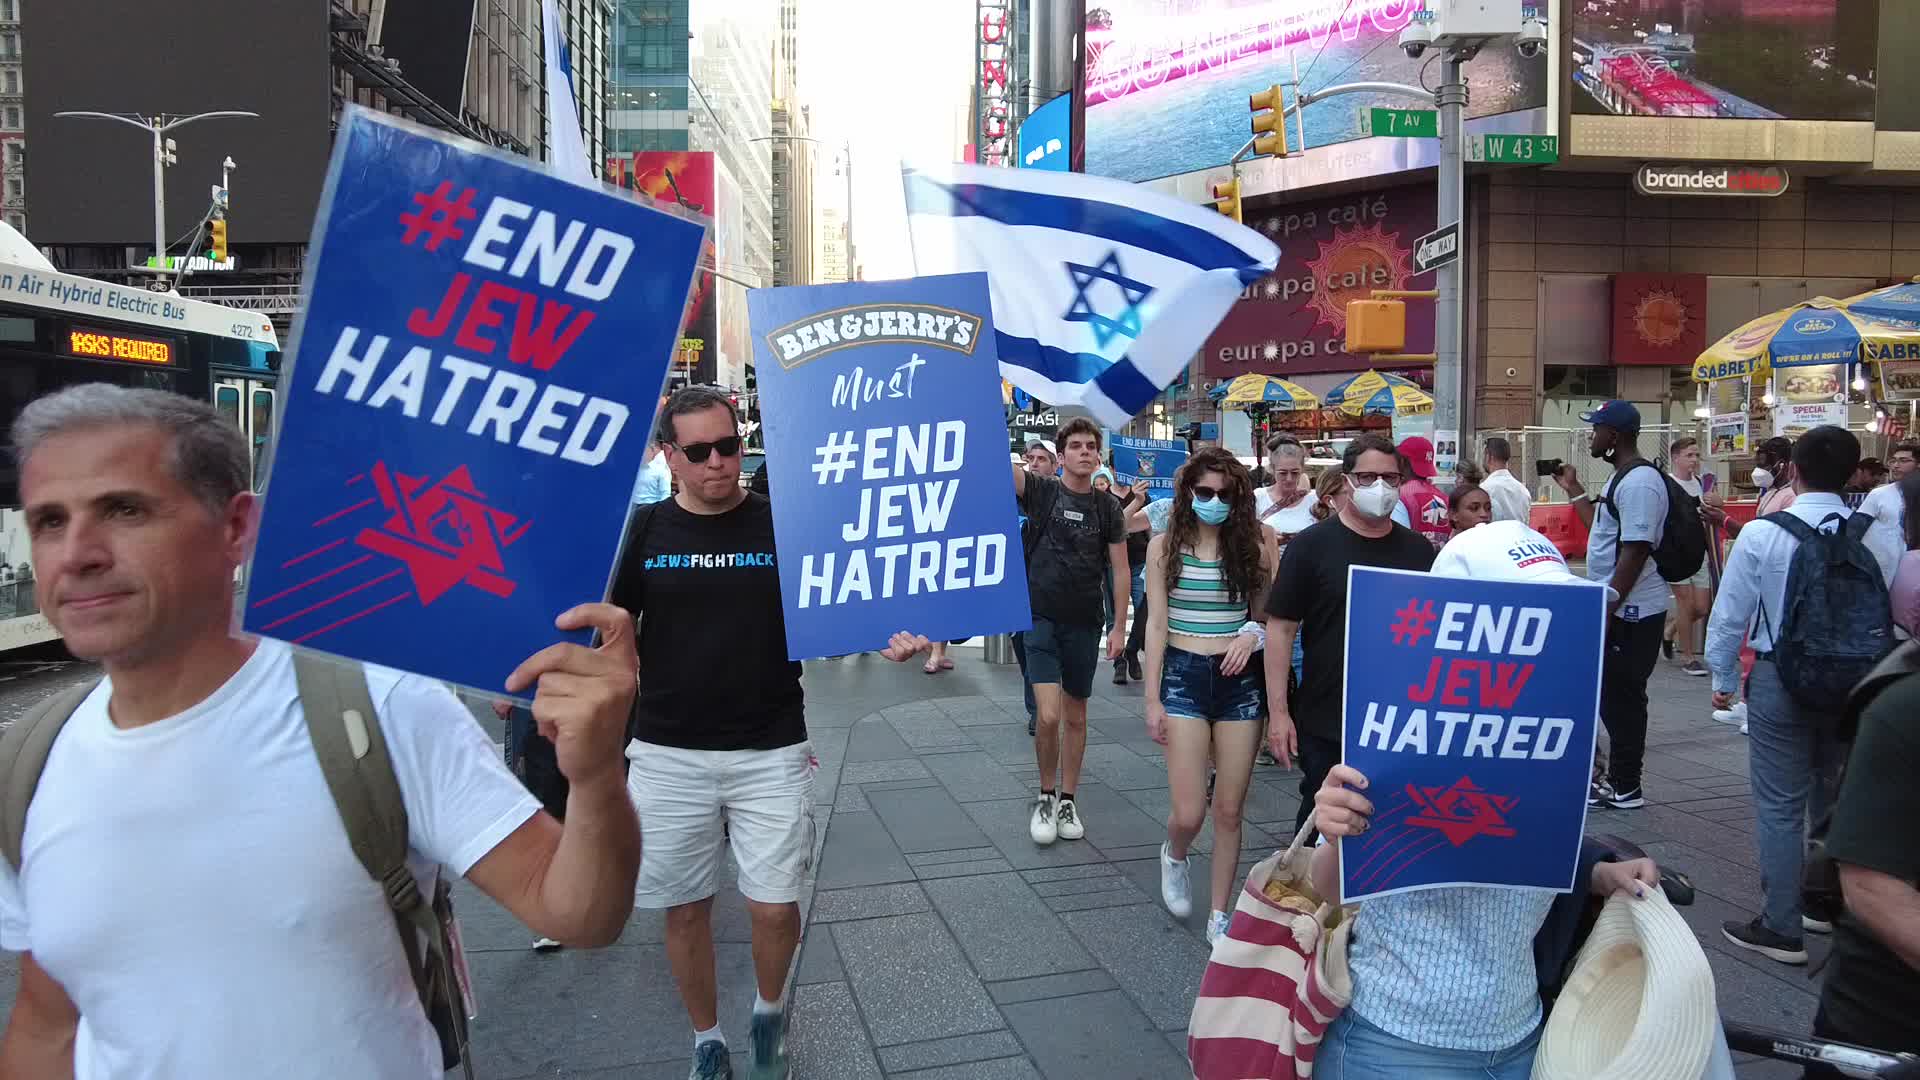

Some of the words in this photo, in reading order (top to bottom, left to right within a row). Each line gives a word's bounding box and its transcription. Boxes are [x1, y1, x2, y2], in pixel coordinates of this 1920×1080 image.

[1522, 8, 1536, 17] YPD
[1388, 113, 1397, 134] 7
[1404, 114, 1420, 127] Av
[1489, 138, 1504, 159] W
[1512, 138, 1533, 159] 43
[1541, 138, 1553, 152] St
[399, 180, 635, 301] #END
[1420, 244, 1432, 261] ONE
[1438, 234, 1454, 255] WAY
[18, 275, 44, 295] Air
[50, 280, 100, 306] Hybrid
[107, 291, 158, 316] Electric
[162, 303, 185, 321] Bus
[231, 323, 253, 338] 4272
[406, 272, 596, 371] JEW
[112, 337, 169, 362] REQUIRED
[1219, 339, 1315, 363] europa
[1822, 352, 1841, 360] ROLL
[315, 325, 631, 467] HATRED
[832, 353, 926, 411] Must
[1792, 405, 1828, 414] SPECIAL
[811, 420, 966, 485] #END
[1122, 437, 1133, 447] END
[1134, 439, 1146, 448] JEW
[1147, 440, 1173, 449] HATRED
[842, 479, 960, 542] JEW
[644, 552, 774, 570] #JEWSFIGHTBACK
[798, 533, 1007, 608] HATRED
[1390, 597, 1553, 656] #END
[1407, 656, 1535, 709] JEW
[1358, 702, 1575, 760] HATRED
